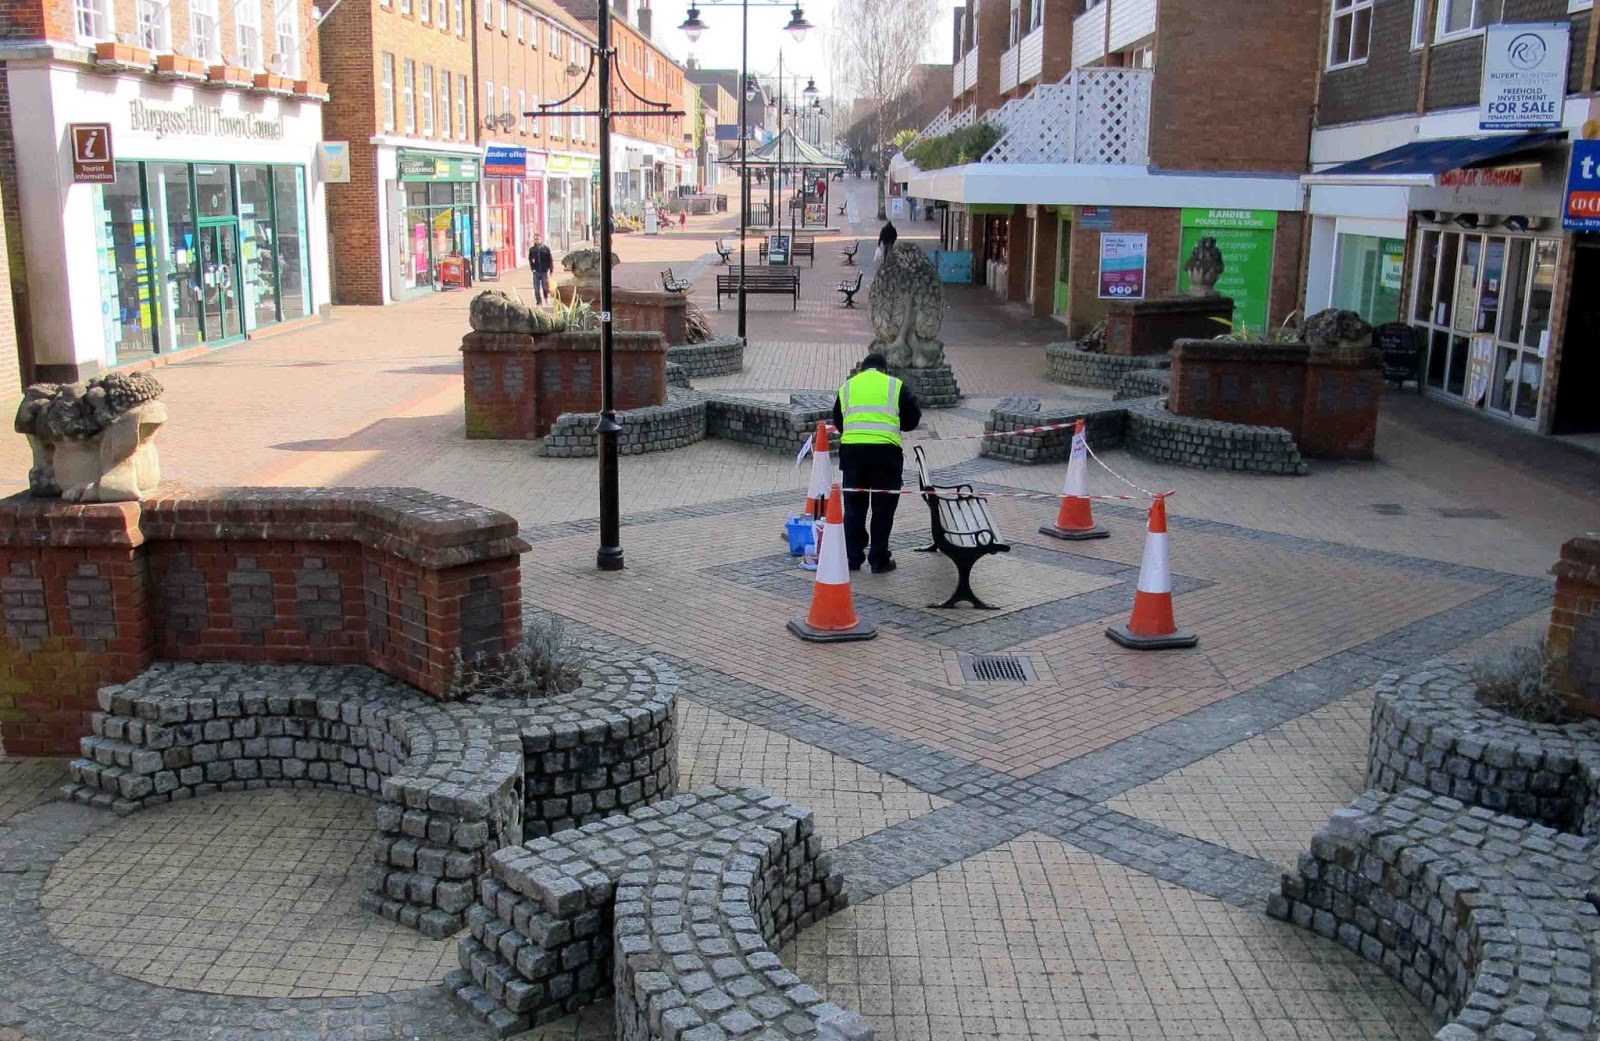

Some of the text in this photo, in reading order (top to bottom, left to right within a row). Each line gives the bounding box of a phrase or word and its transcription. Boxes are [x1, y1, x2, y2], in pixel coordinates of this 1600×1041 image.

[1488, 101, 1555, 114] FOR SALE
[129, 99, 284, 140] Burgess Hill Town Council
[1208, 210, 1251, 218] KANDIES
[604, 312, 609, 320] 2
